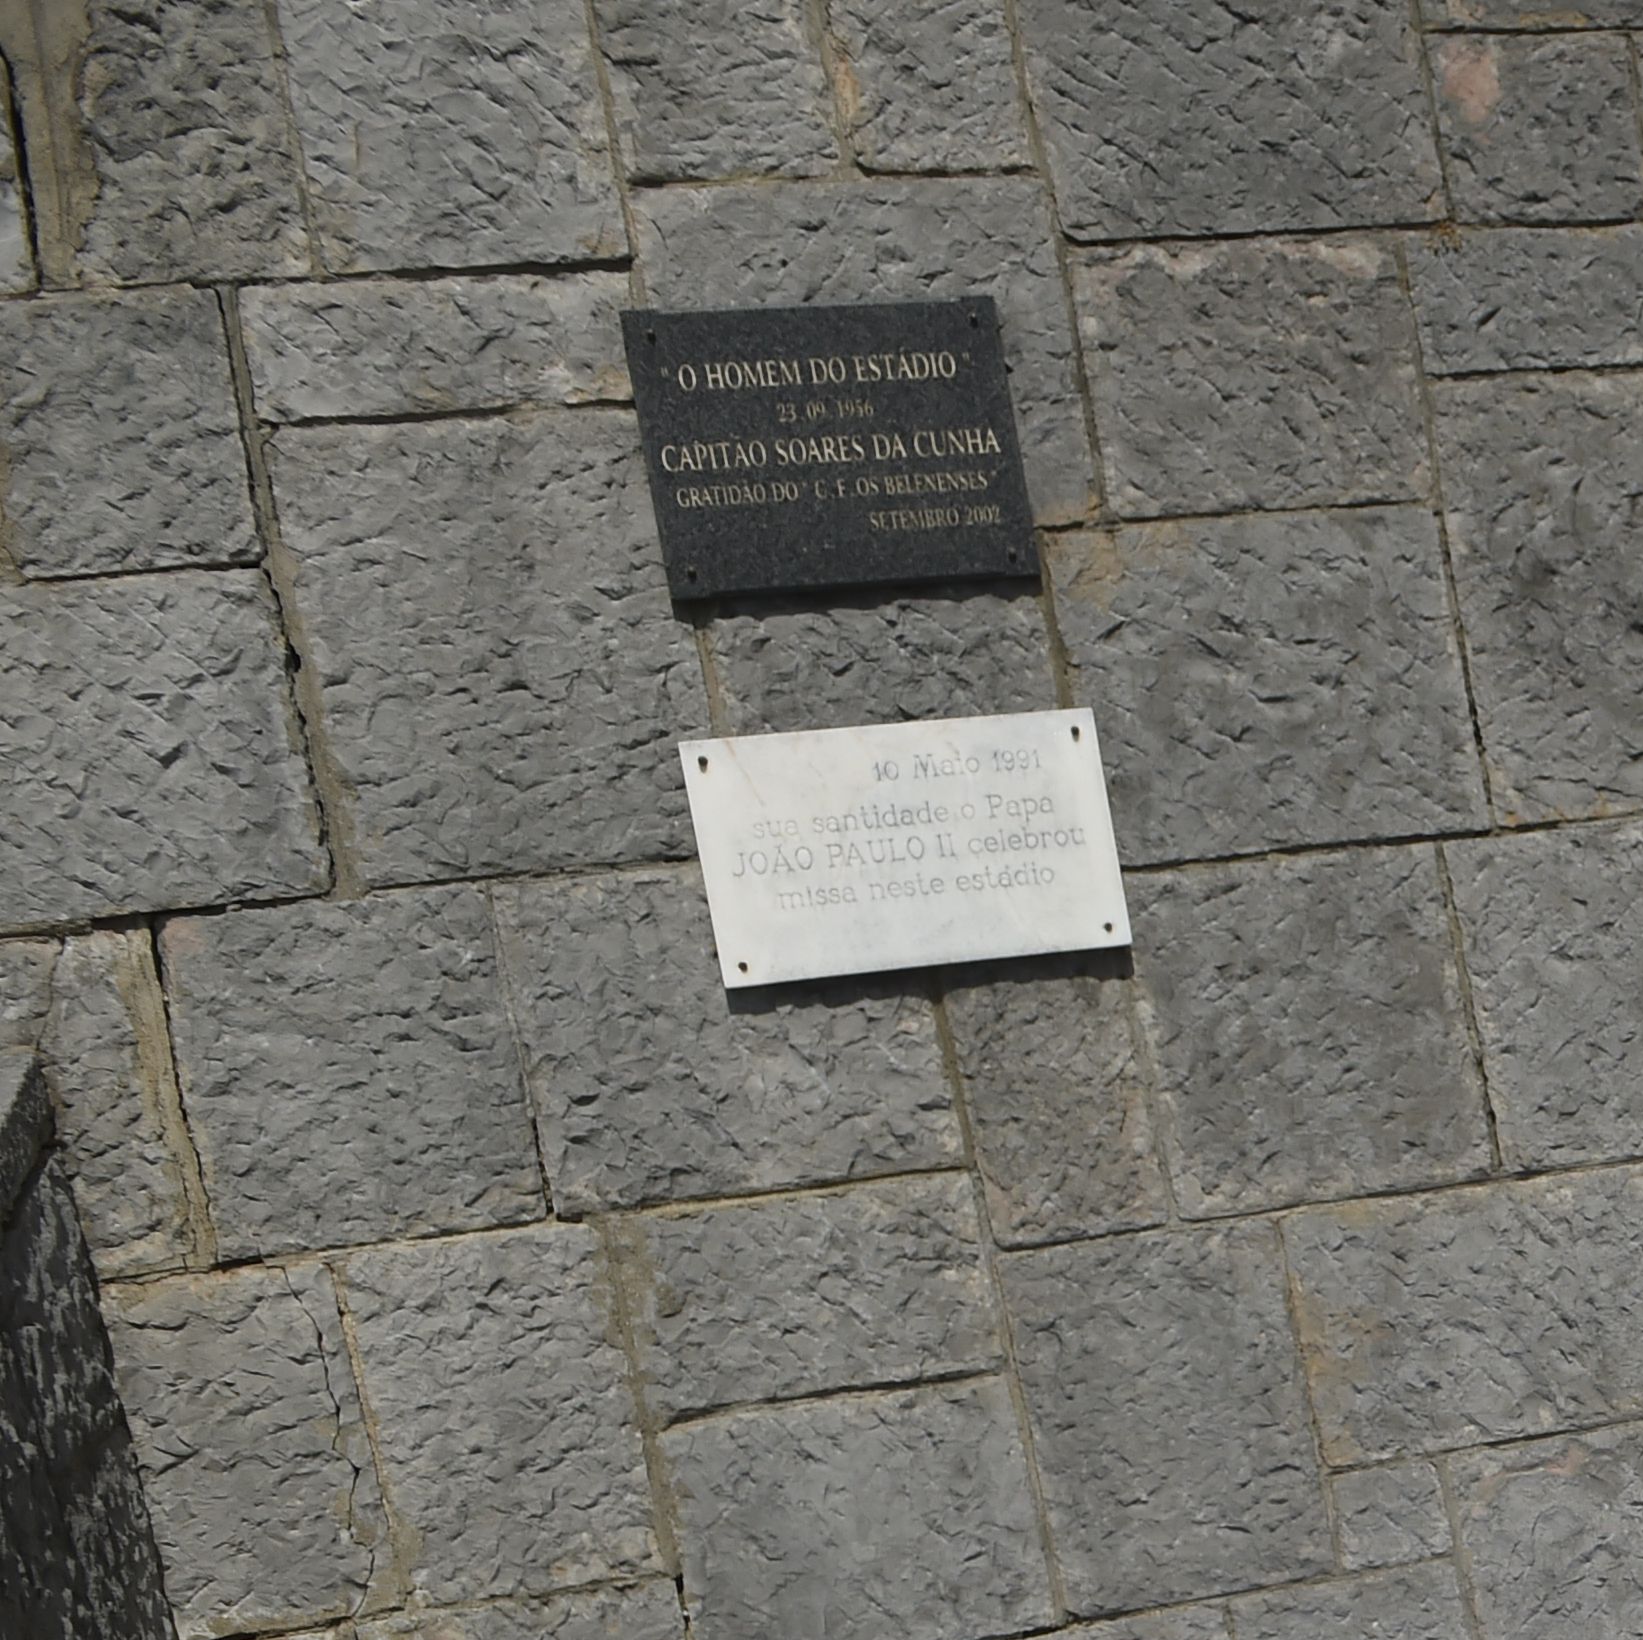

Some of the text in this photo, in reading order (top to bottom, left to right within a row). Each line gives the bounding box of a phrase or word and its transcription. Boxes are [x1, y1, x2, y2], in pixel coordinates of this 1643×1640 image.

[705, 360, 802, 389] HOMEM
[810, 356, 846, 384] DO
[661, 428, 1001, 472] CAPITÃO SOARES DA CUNHA
[676, 480, 766, 508] GRATIDÃO
[771, 481, 798, 502] DO
[856, 477, 879, 496] OS
[870, 505, 1000, 530] SETEMBRO 2002
[872, 749, 1042, 781] 10 Maio 1991
[753, 794, 1054, 838] sua santidade o Papa
[732, 845, 814, 878] JOÃO
[827, 835, 925, 869] PAULO
[967, 826, 1086, 855] celebrou
[779, 864, 1055, 911] missa neste estádio
